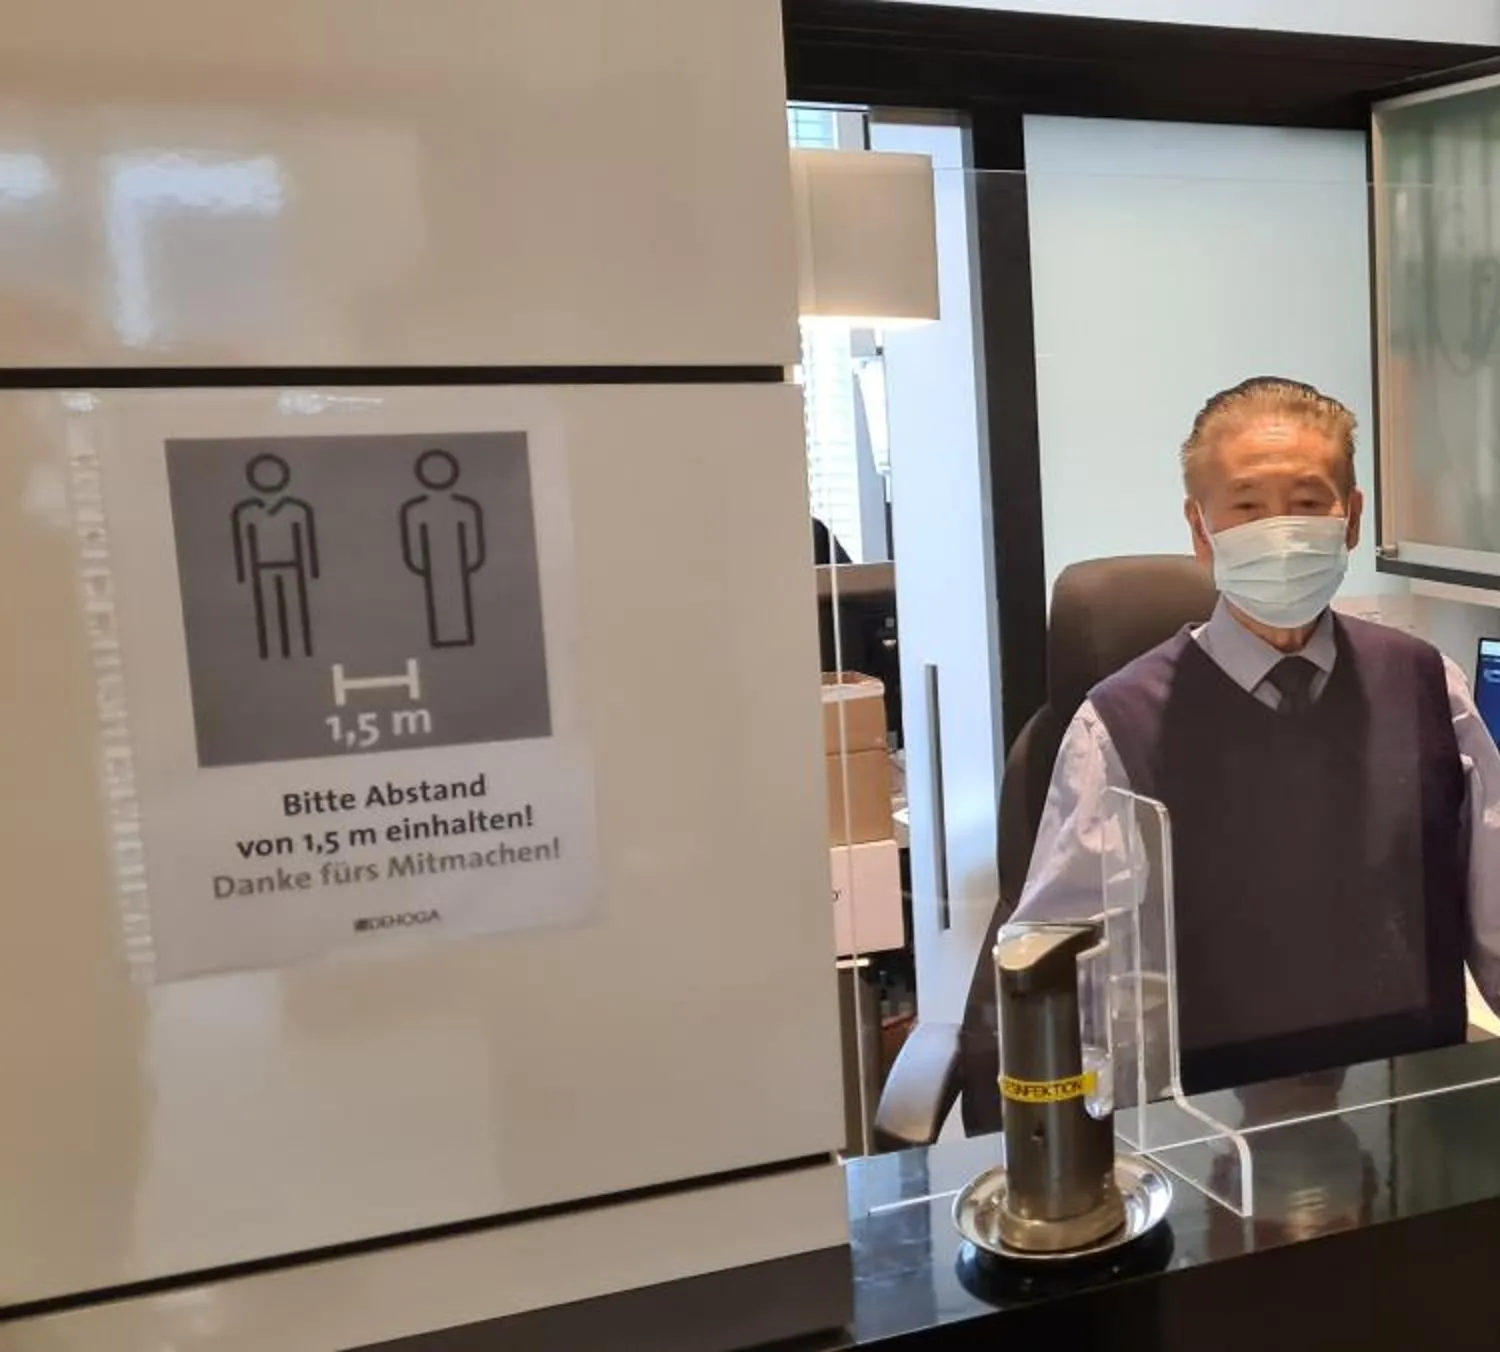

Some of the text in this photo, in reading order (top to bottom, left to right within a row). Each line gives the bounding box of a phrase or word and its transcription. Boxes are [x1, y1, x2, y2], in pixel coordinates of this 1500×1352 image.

[325, 707, 433, 748] 1,5 m
[282, 773, 487, 817] Bitte Abstand
[236, 804, 535, 859] von 1,5 m einhalten!
[213, 837, 561, 900] Danke fürs Mitmachen!
[367, 907, 442, 930] DEHOGA
